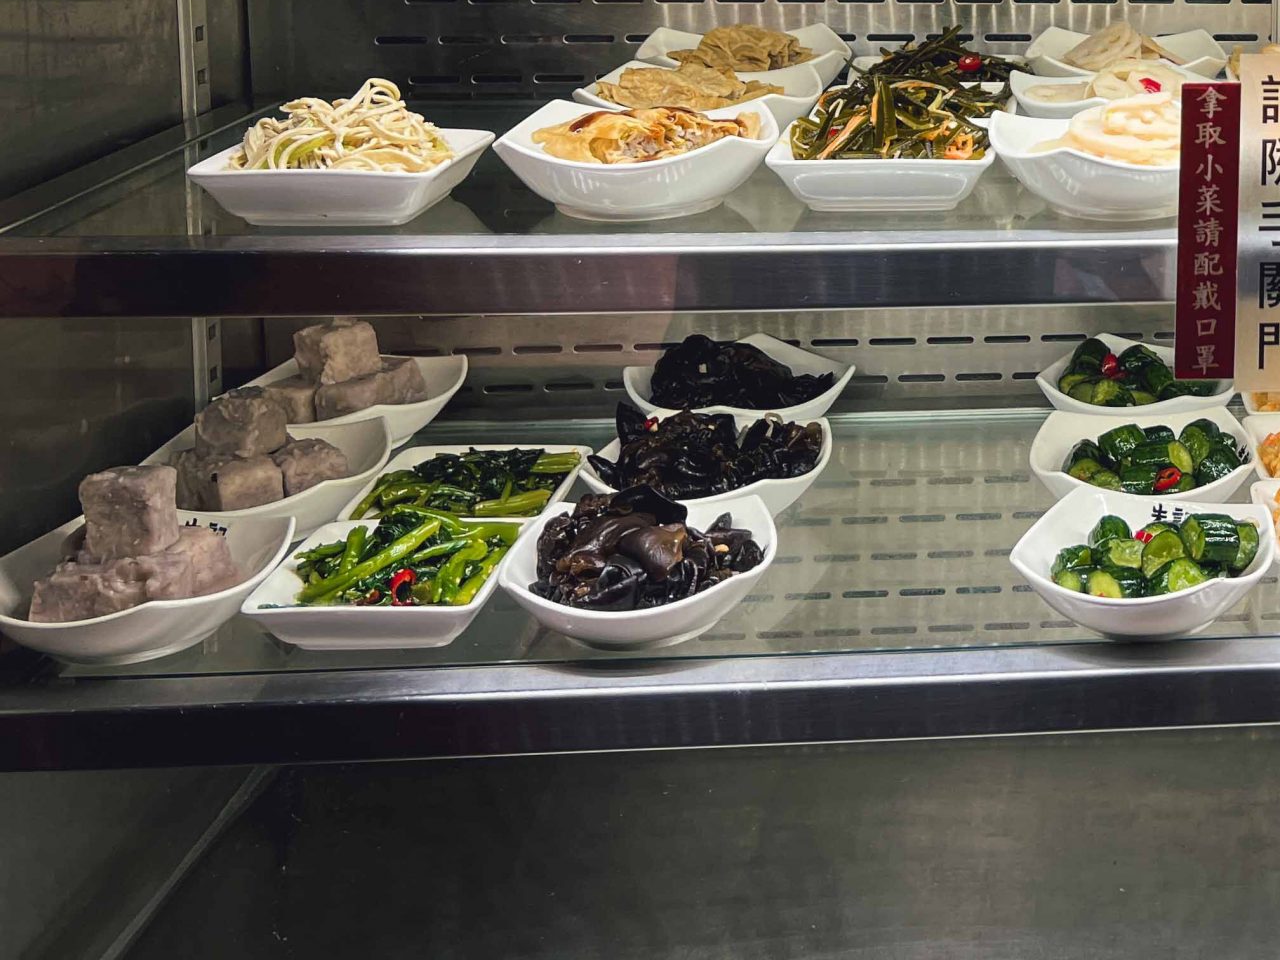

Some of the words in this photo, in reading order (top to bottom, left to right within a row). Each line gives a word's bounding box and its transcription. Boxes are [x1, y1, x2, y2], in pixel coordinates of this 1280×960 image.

[1191, 88, 1228, 375] 拿取小菜請配戴口罩
